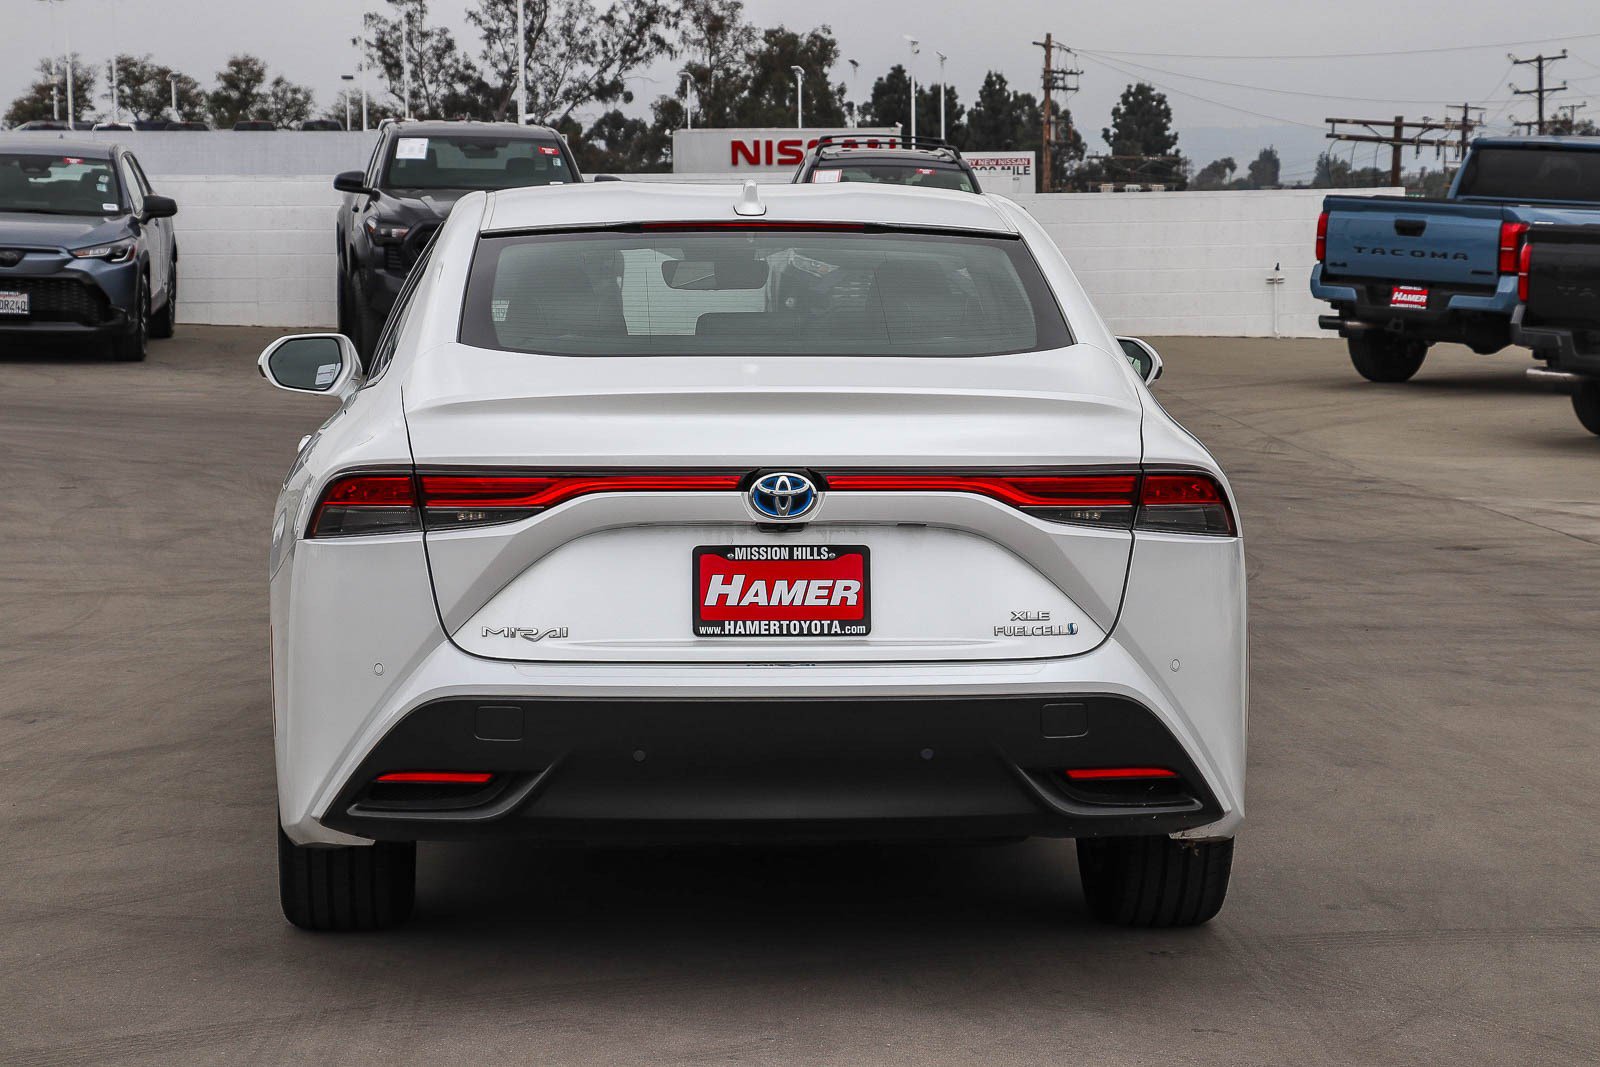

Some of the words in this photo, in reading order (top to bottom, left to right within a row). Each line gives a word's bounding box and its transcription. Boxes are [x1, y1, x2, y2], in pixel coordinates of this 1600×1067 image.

[978, 158, 997, 166] NEW
[998, 158, 1029, 166] NISSAN
[1353, 246, 1469, 261] TACOMA
[1392, 291, 1427, 303] HAMER
[734, 546, 789, 560] MISSION
[793, 546, 829, 560] HILLS
[703, 573, 862, 607] HAMER
[1010, 610, 1050, 621] XLE
[481, 626, 569, 642] MIRAI
[699, 620, 866, 635] www.HAMERTOYOTA.com
[993, 625, 1070, 637] FUELCELL
